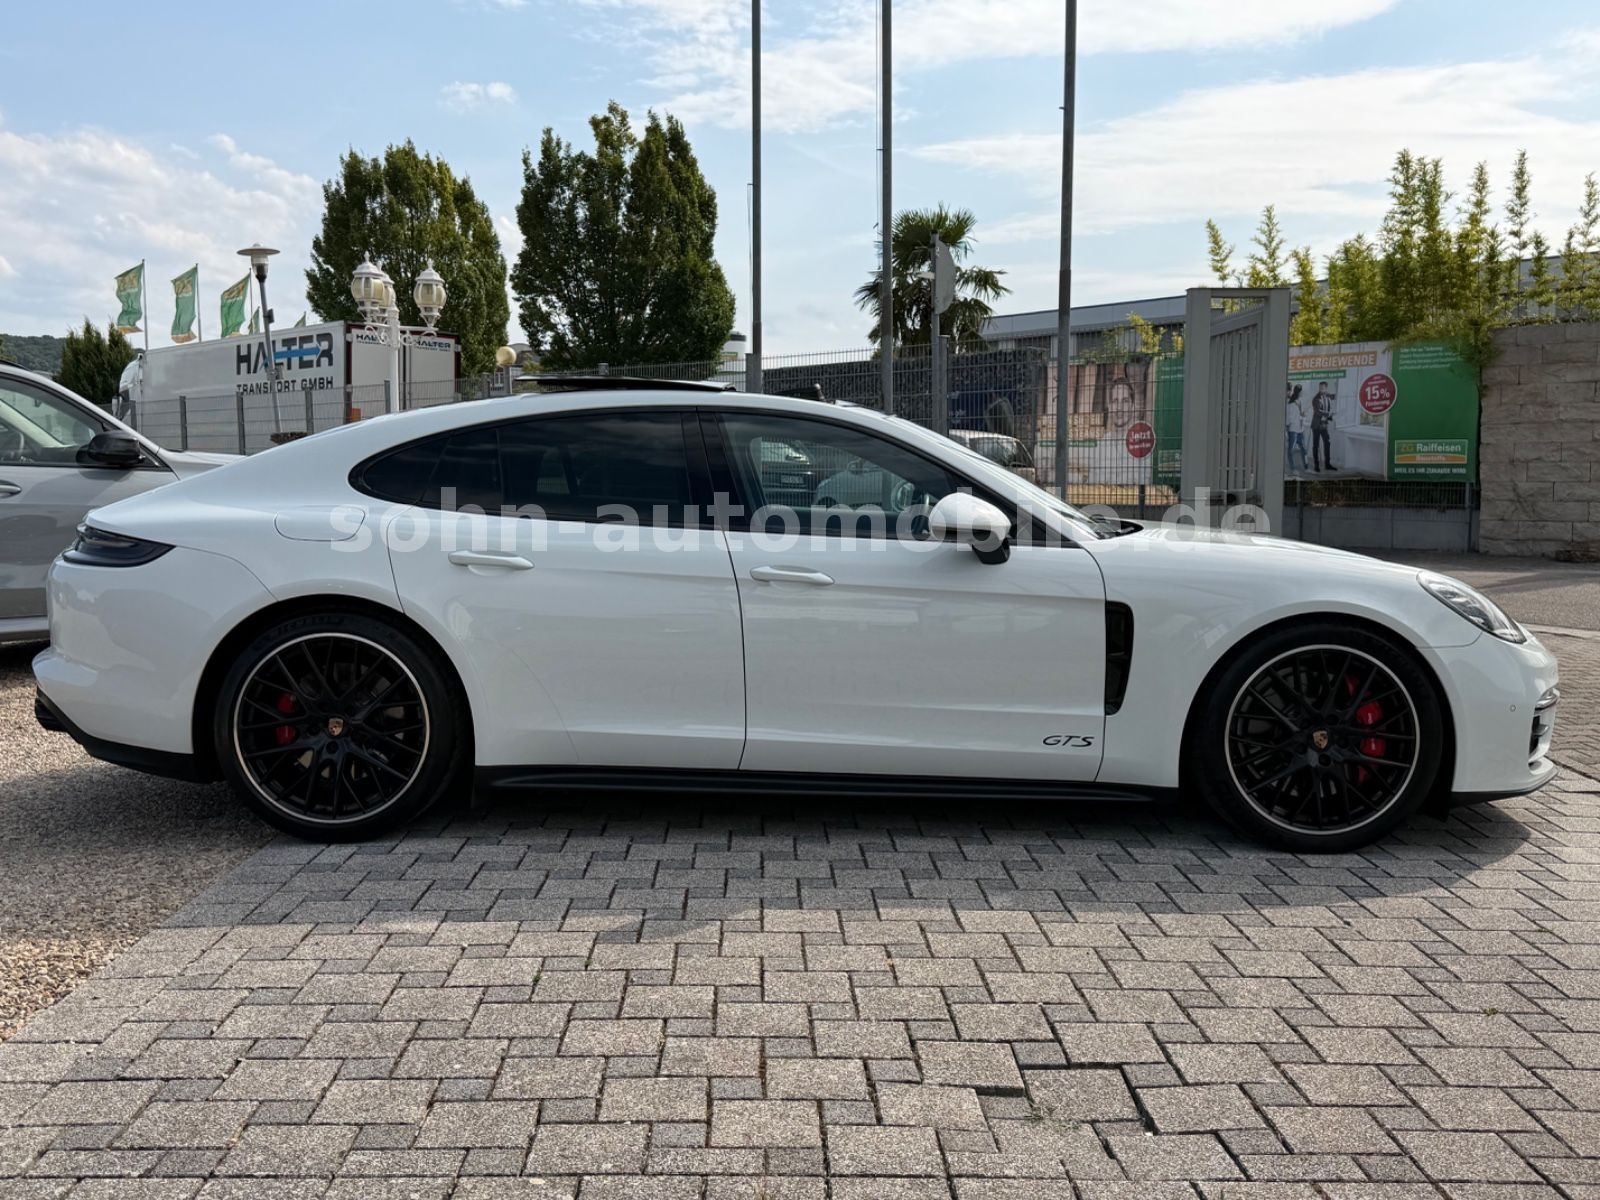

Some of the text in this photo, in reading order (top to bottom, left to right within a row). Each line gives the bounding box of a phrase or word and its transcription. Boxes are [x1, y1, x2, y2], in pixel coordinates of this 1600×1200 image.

[236, 332, 333, 375] HALTER
[1296, 354, 1375, 369] ENERGIEWENDE
[301, 376, 334, 391] GMBH
[1365, 385, 1391, 400] 15%
[1416, 443, 1462, 452] Raiffeisen
[1042, 734, 1095, 748] GTS
